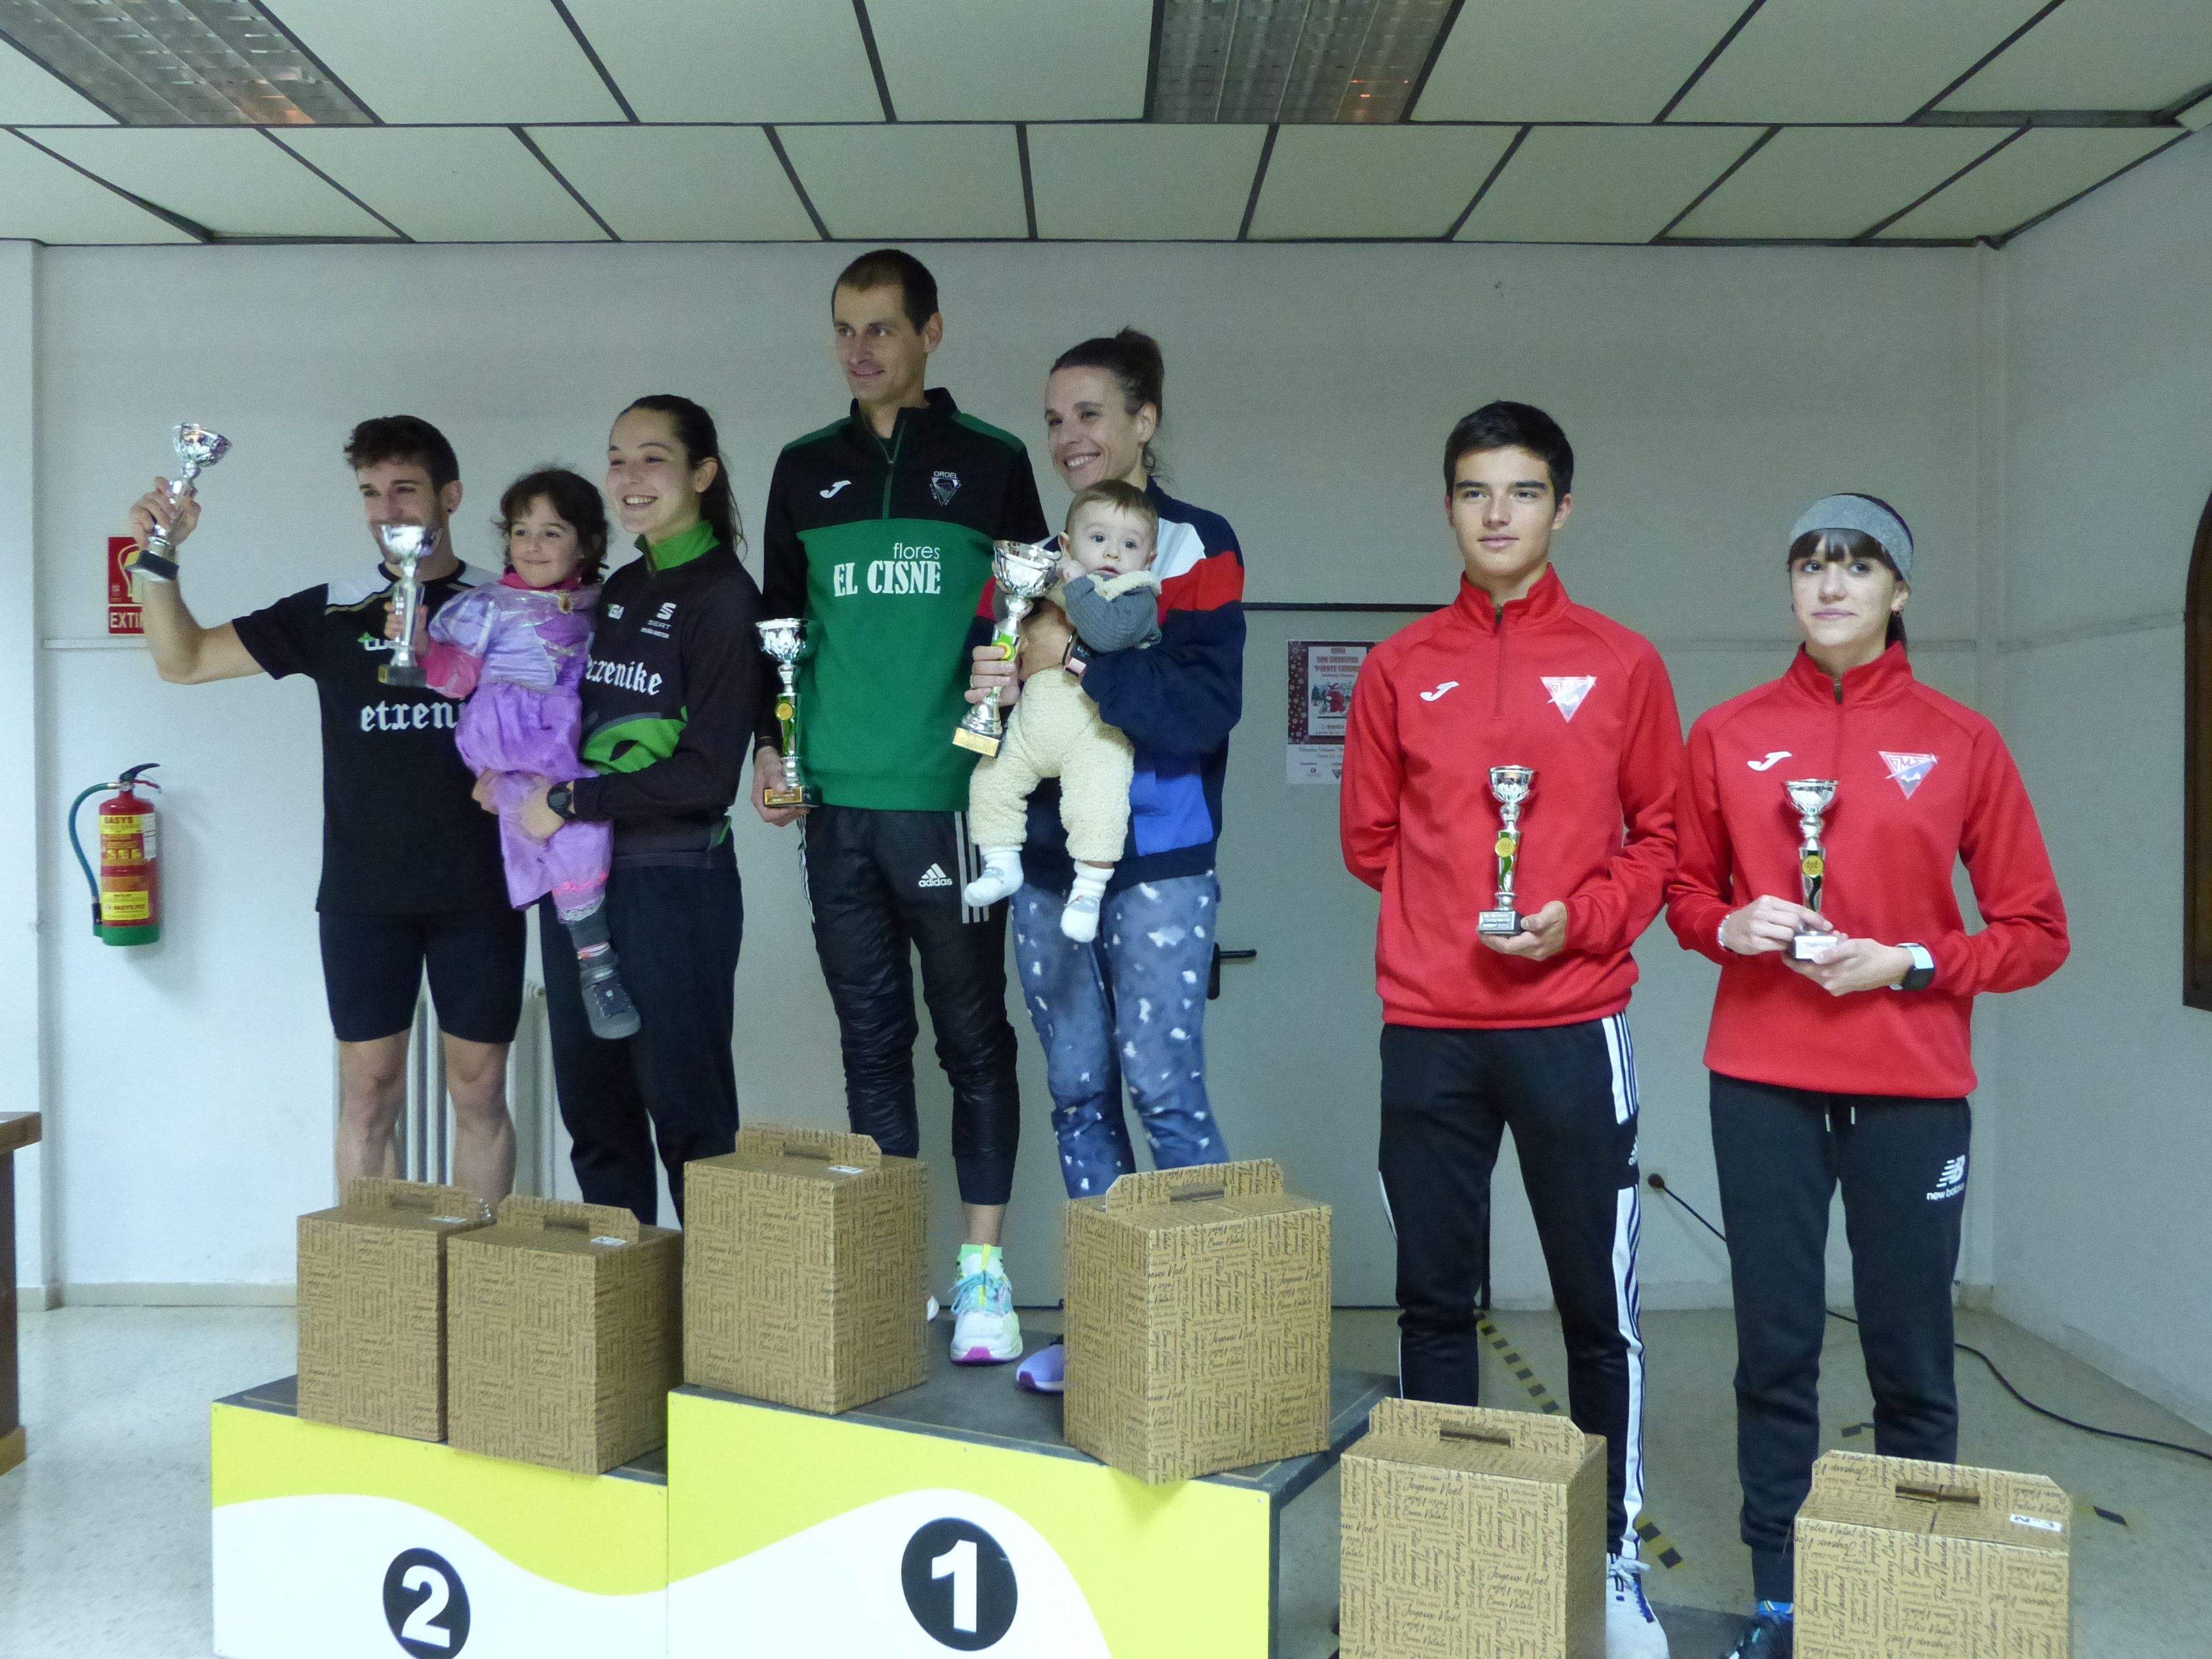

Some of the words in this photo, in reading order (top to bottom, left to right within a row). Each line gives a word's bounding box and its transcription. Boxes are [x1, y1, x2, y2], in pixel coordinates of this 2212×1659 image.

[933, 471, 958, 479] OROEL
[893, 542, 941, 560] flores
[833, 562, 858, 597] EL
[867, 560, 941, 594] CISNE
[111, 612, 143, 628] EXTI
[647, 619, 672, 630] SEAT
[919, 878, 953, 887] adidas
[1927, 1192, 1945, 1201] new
[931, 1539, 977, 1634] 1
[400, 1565, 451, 1648] 2
